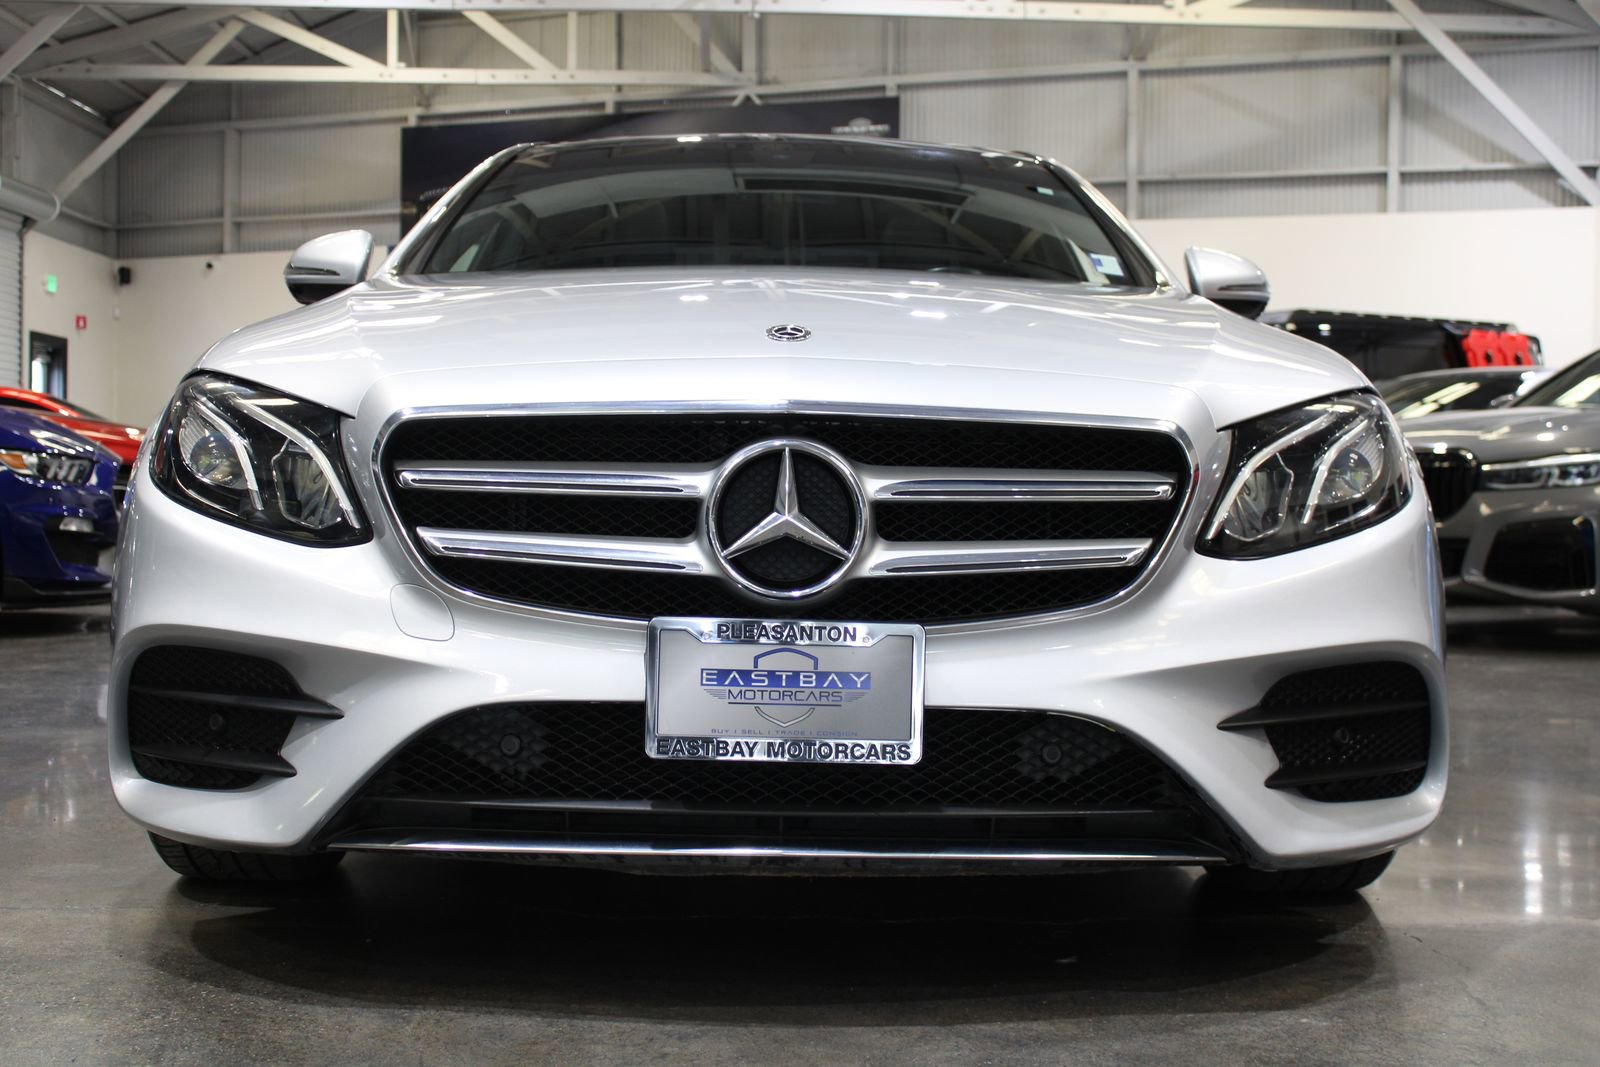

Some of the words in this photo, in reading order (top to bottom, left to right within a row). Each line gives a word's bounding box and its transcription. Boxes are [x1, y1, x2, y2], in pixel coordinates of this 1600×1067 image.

[716, 623, 857, 643] PLEASANTON
[702, 670, 869, 688] EASTBAY
[727, 688, 843, 702] MOTORCARS
[656, 738, 758, 757] EASTBAY
[766, 740, 911, 761] MOTORCARS
